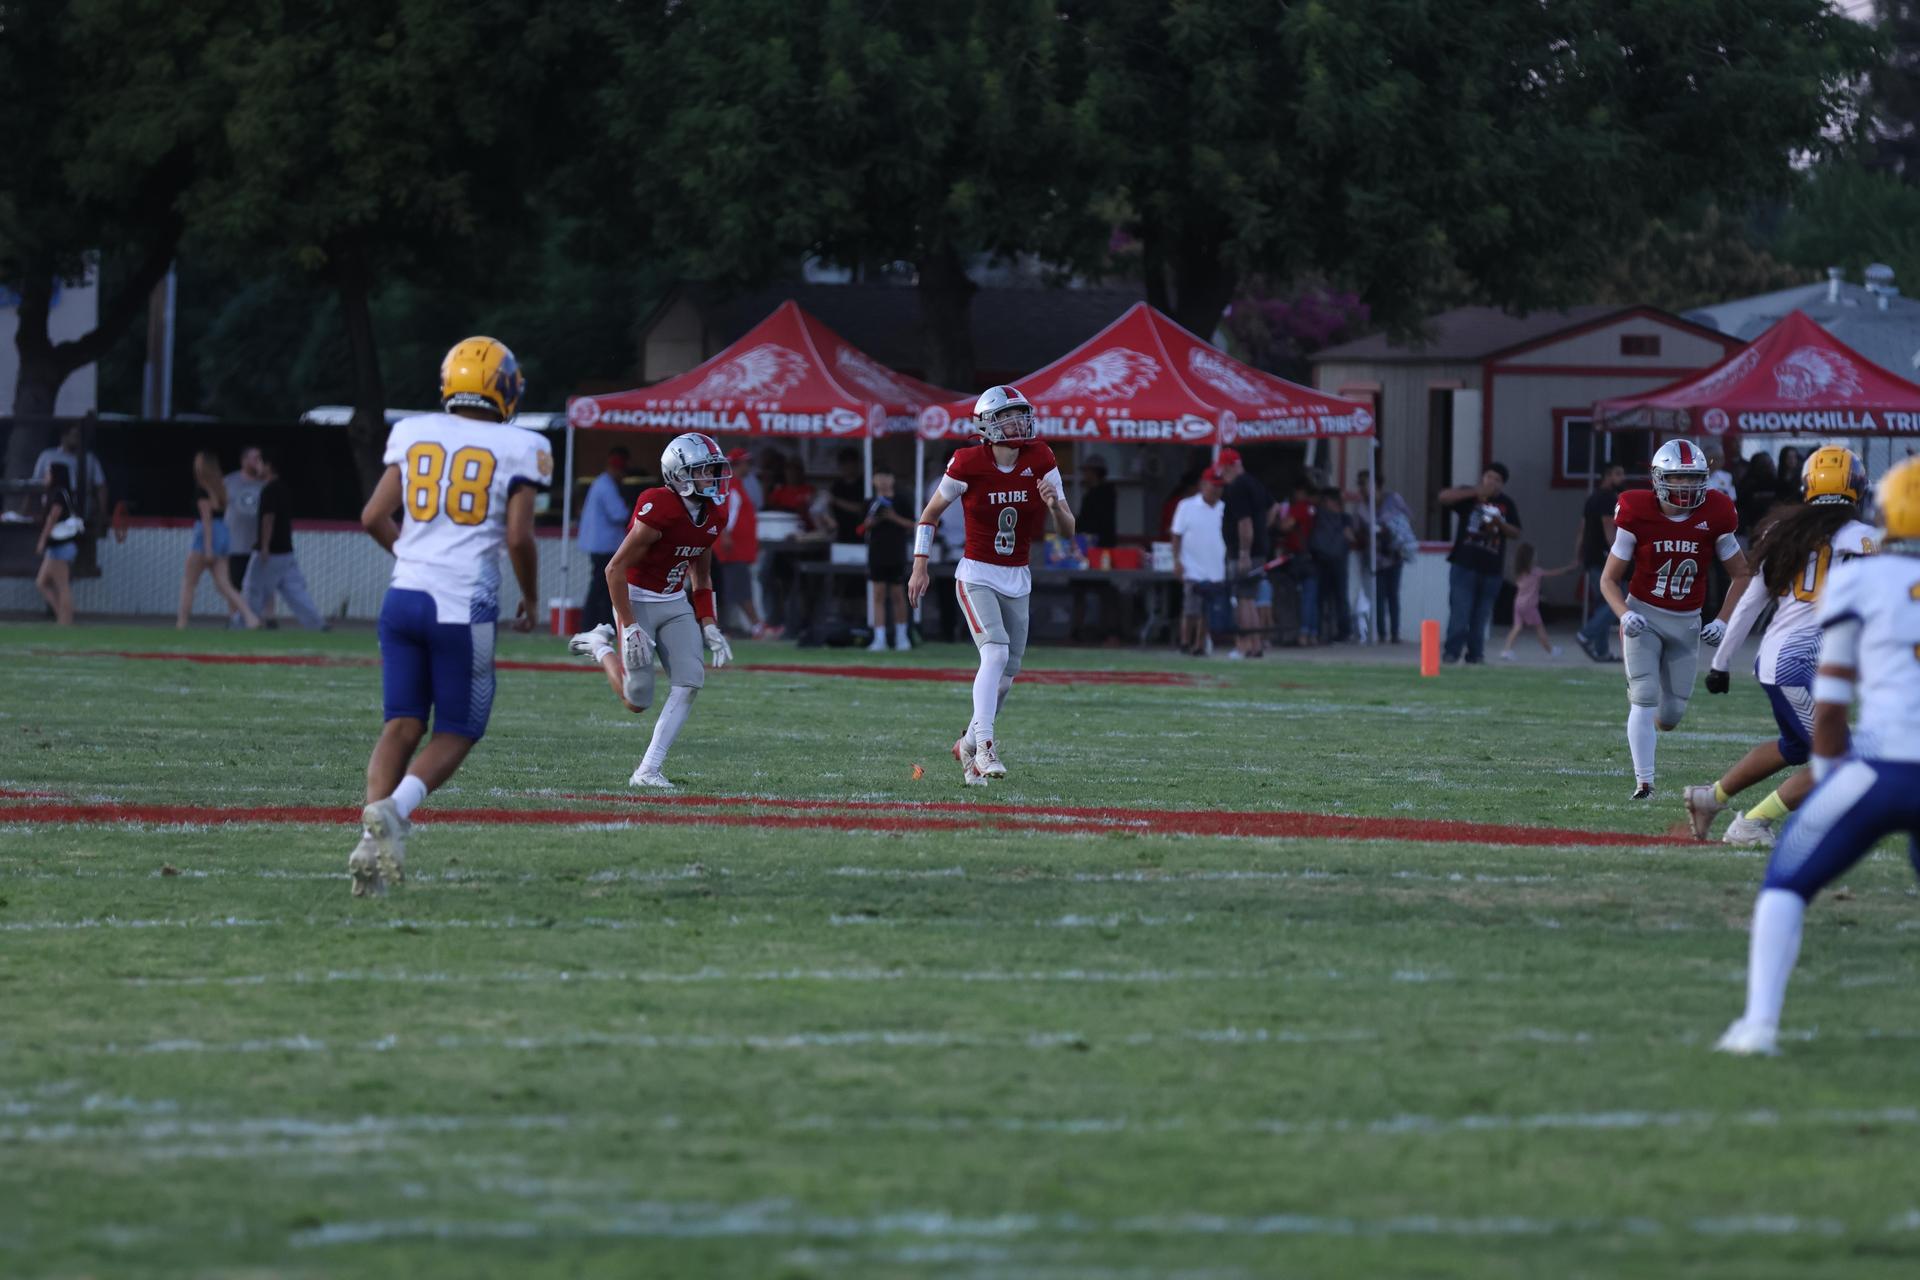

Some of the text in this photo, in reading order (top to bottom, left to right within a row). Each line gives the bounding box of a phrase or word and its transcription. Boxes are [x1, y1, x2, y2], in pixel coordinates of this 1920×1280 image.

[602, 409, 751, 430] CHOWCHILLA
[758, 412, 825, 433] TRIBE
[1107, 419, 1174, 439] TRIBE
[1738, 410, 1920, 431] CHOWCHILLA TRI
[406, 441, 497, 526] 88
[988, 490, 1028, 504] TRIBE
[638, 502, 653, 516] 9
[994, 506, 1018, 556] 8
[1653, 540, 1699, 554] TRIBE
[1650, 558, 1698, 600] 10
